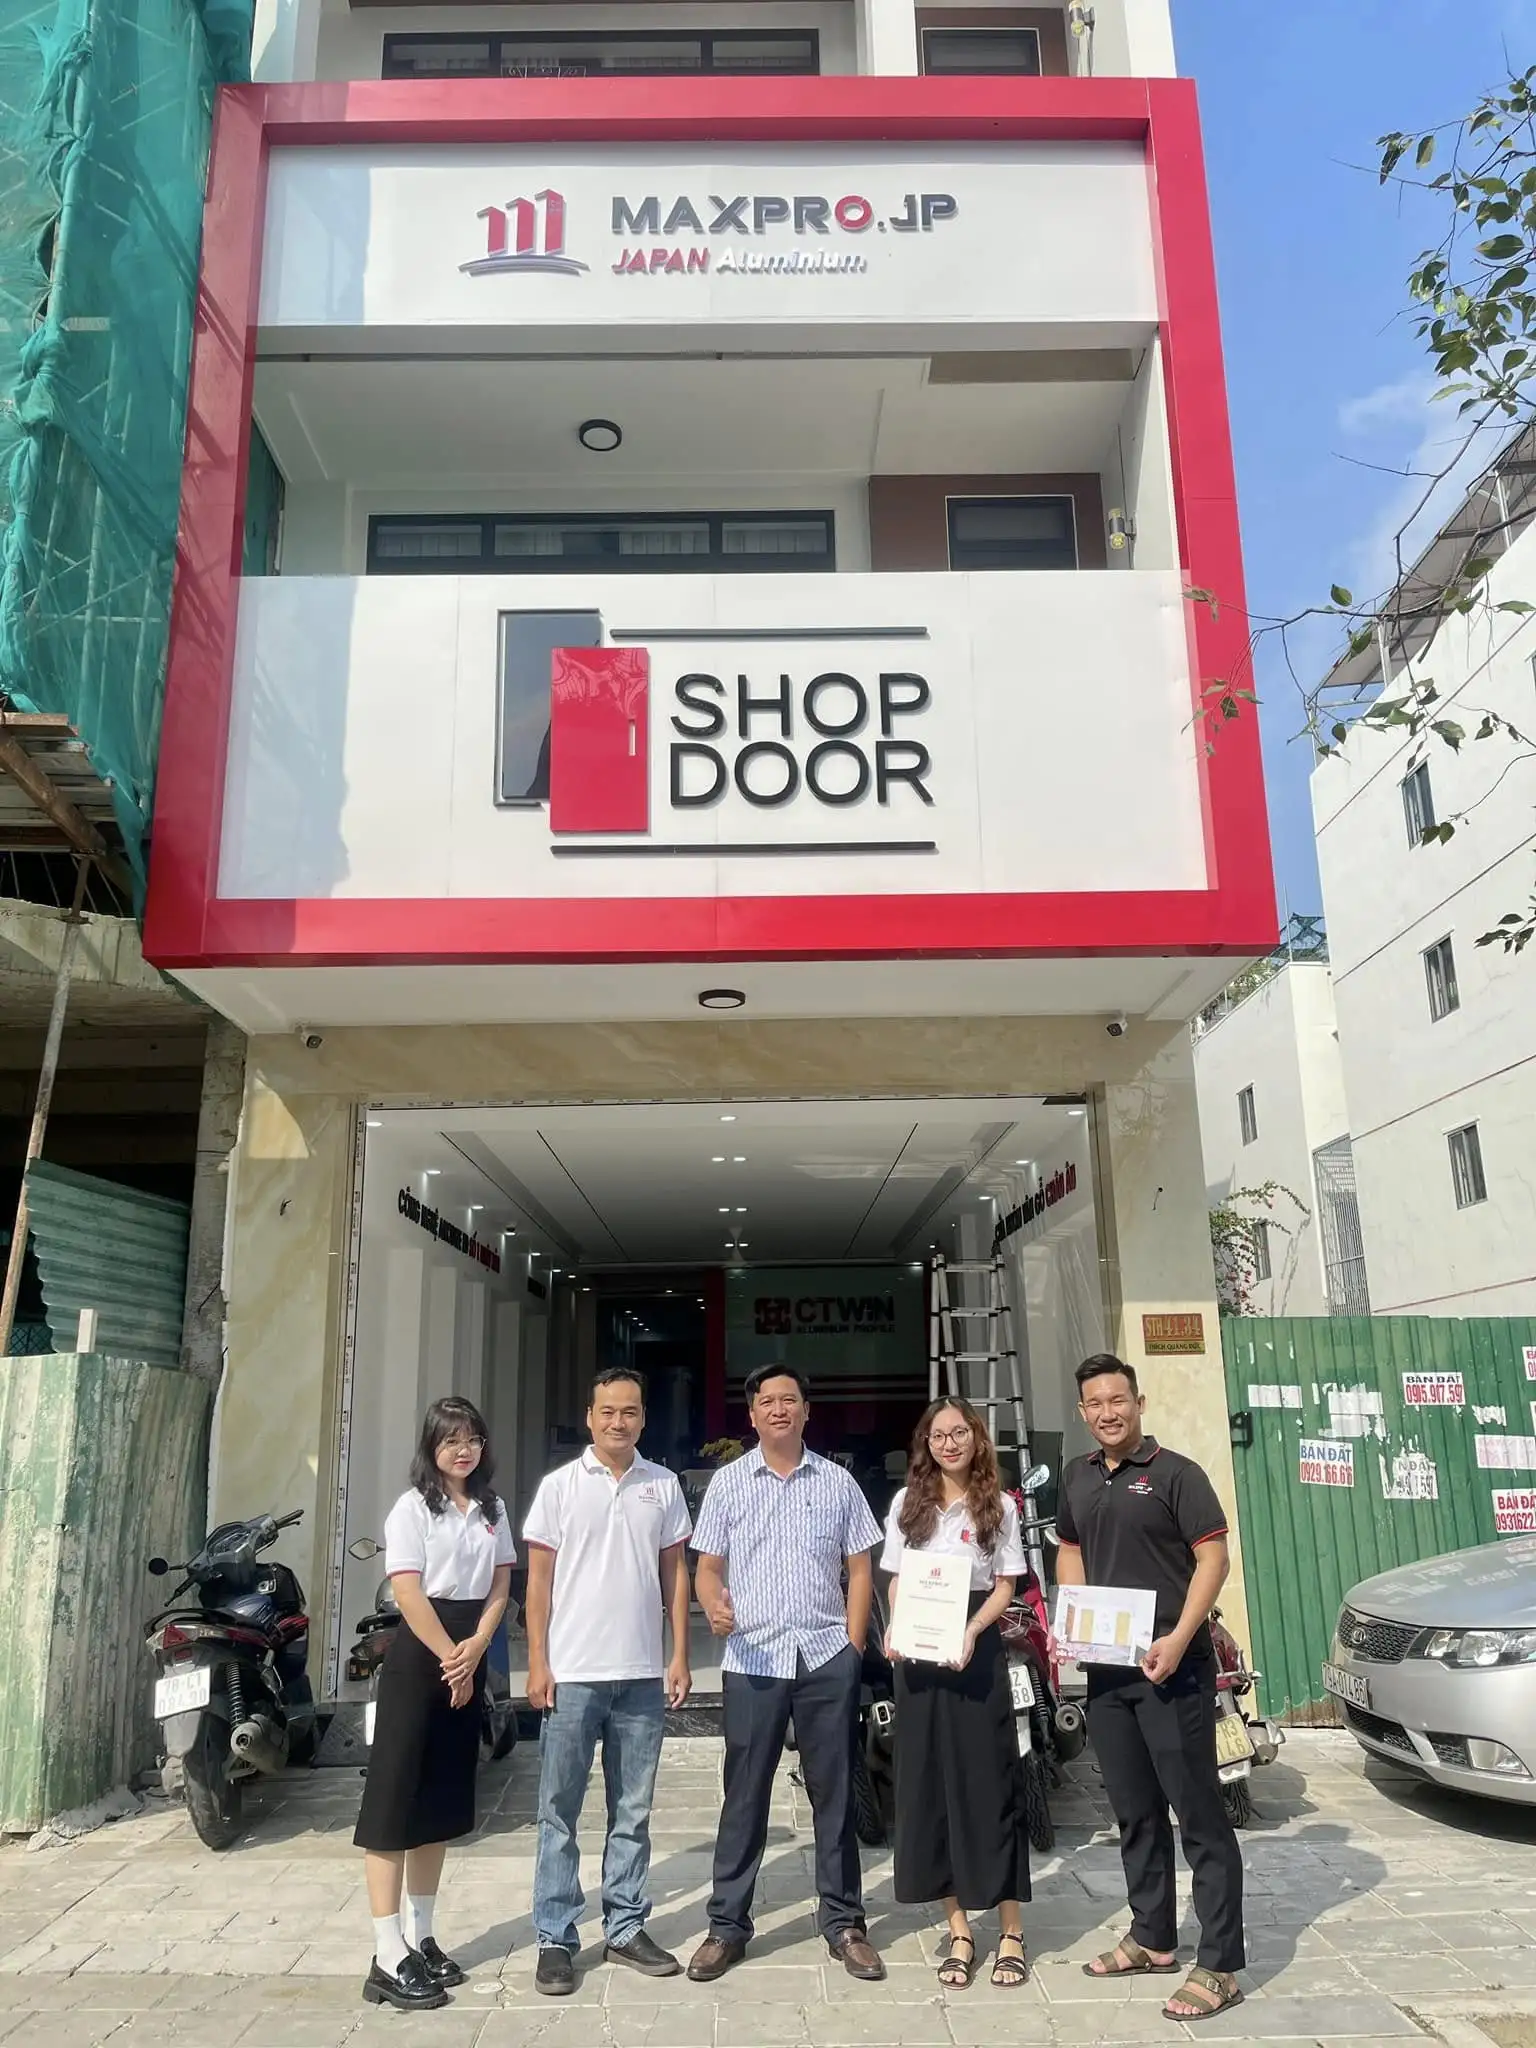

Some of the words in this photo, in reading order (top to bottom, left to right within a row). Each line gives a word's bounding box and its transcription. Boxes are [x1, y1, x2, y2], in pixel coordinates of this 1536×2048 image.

[612, 194, 959, 234] MAXPRO.JP
[612, 247, 709, 273] JAPAN
[714, 245, 867, 273] Aluminium
[670, 672, 932, 739] SHOP
[670, 740, 935, 808] DOOR
[795, 1296, 896, 1323] CTWIN
